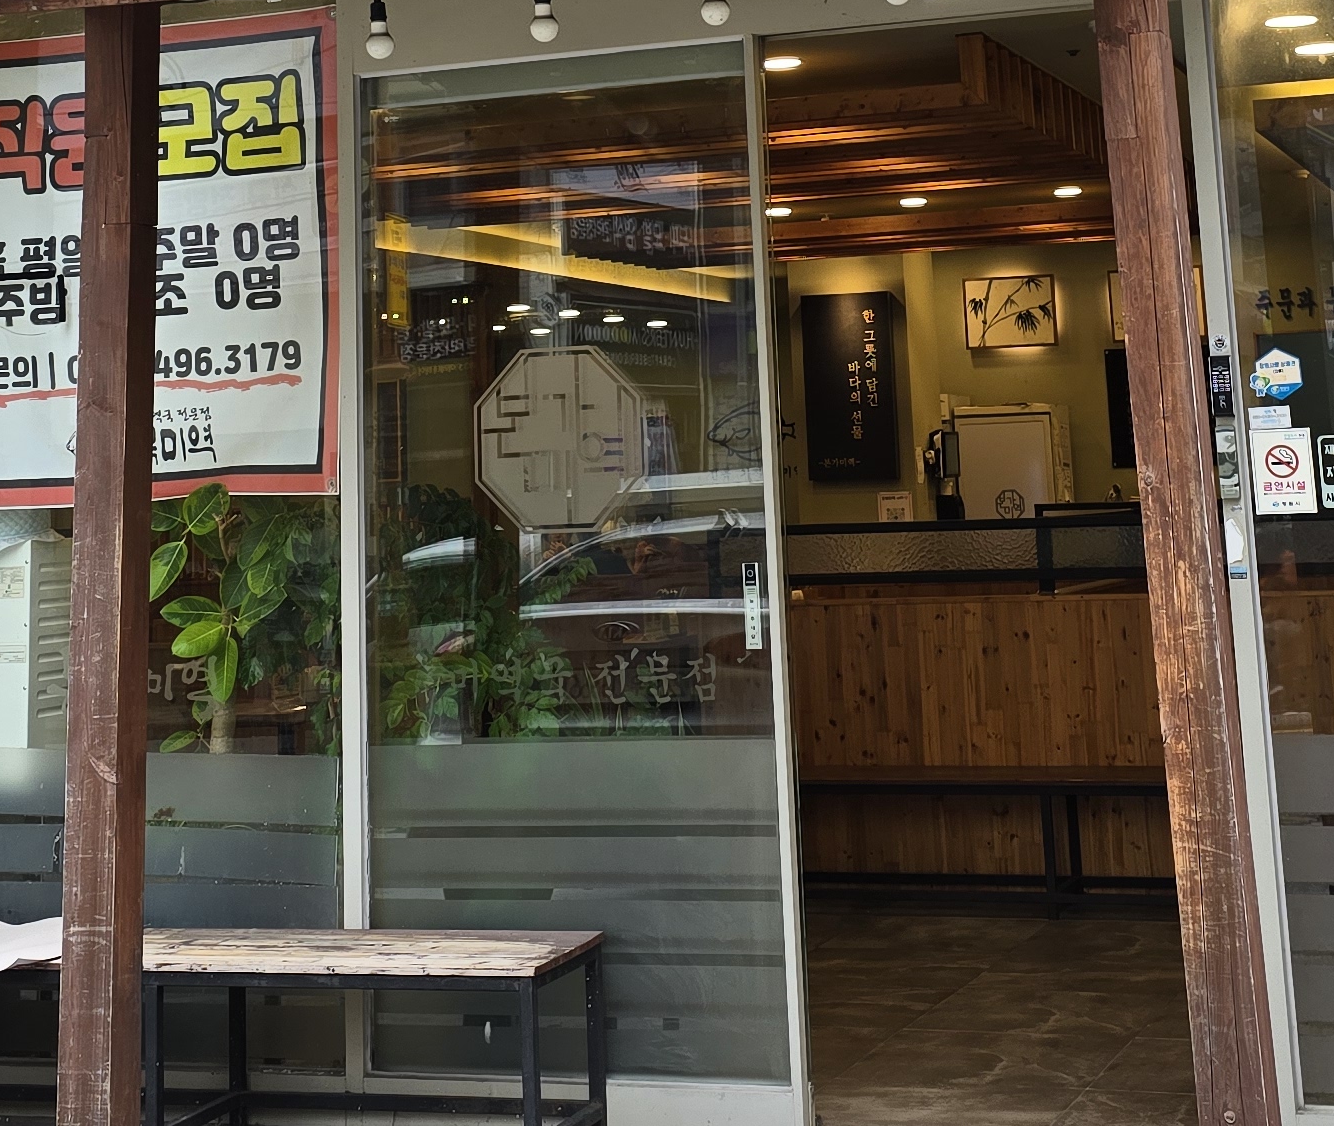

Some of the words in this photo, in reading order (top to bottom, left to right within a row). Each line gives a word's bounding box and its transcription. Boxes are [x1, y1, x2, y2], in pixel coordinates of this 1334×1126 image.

[847, 360, 862, 406] 바다의
[153, 423, 218, 466] 미역
[850, 410, 864, 440] 선물
[1262, 479, 1307, 494] 금연시설
[594, 652, 718, 705] 전문점
